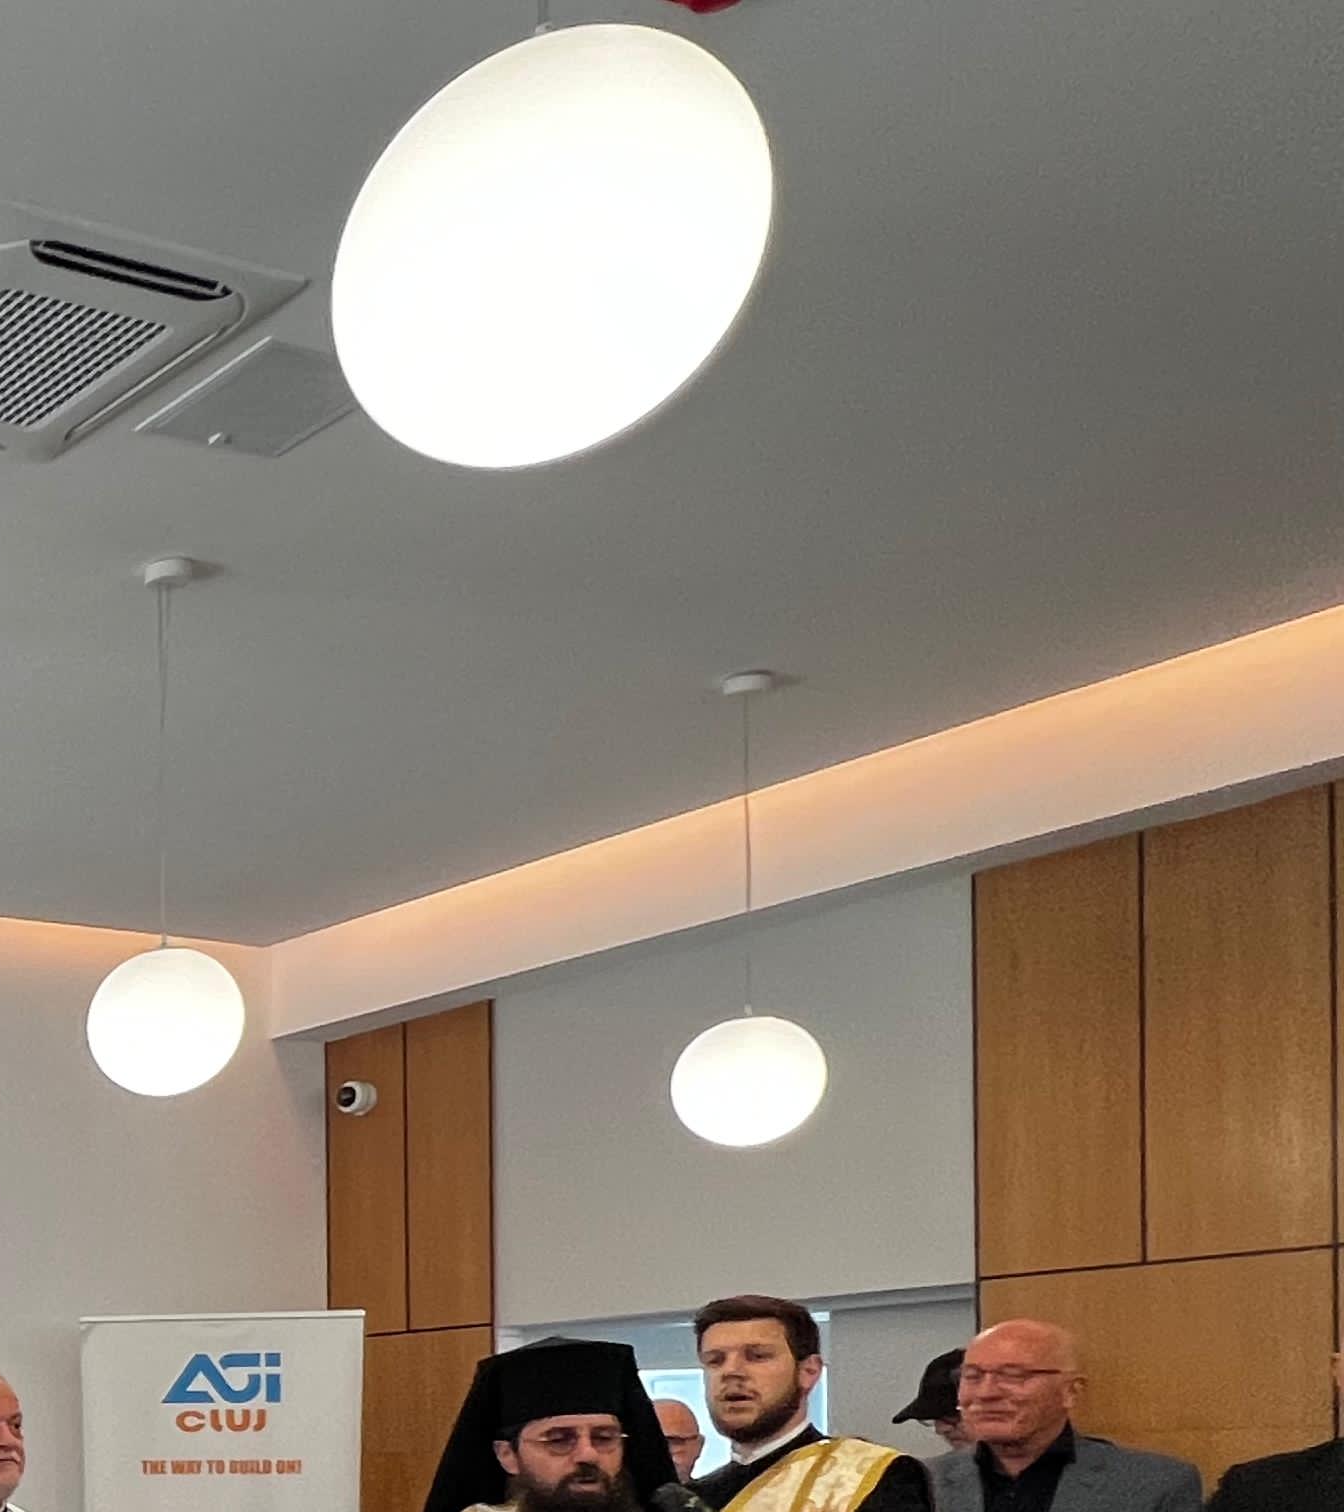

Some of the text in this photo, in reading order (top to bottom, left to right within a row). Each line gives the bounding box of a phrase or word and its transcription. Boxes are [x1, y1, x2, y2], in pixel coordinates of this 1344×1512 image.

[141, 1459, 167, 1475] THE
[170, 1459, 202, 1475] WAY
[206, 1459, 226, 1475] TO
[228, 1459, 273, 1475] BUILD
